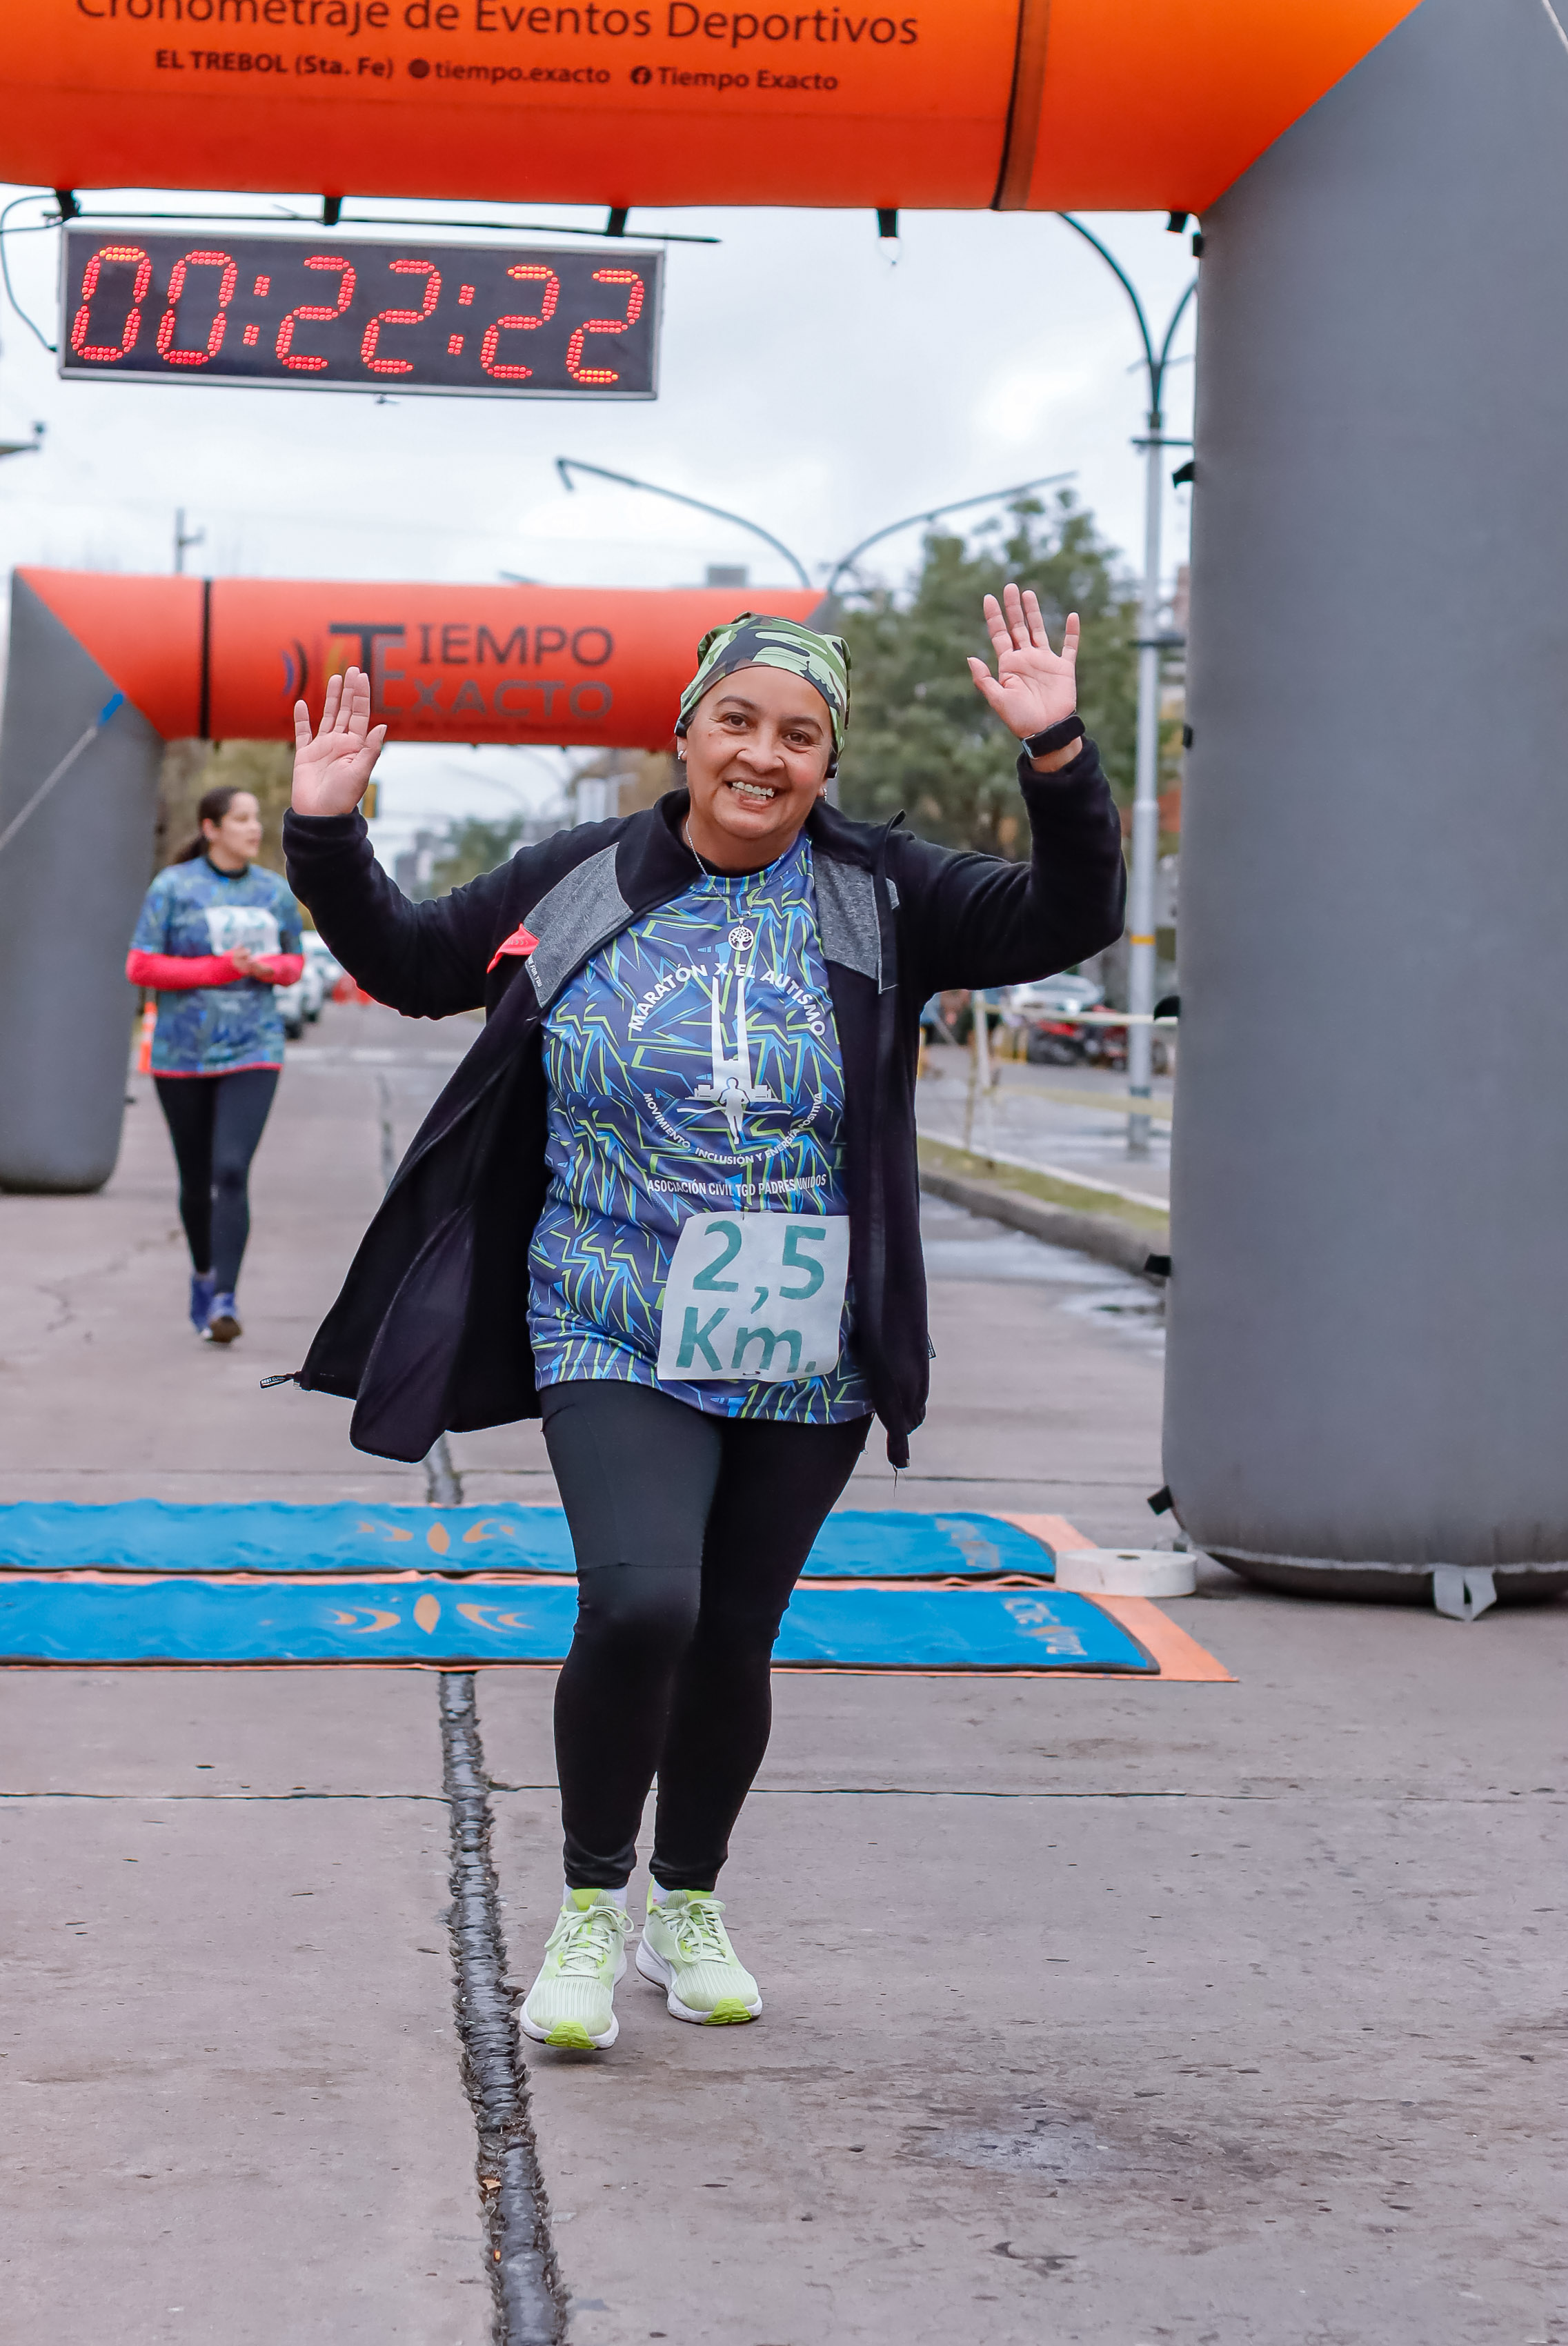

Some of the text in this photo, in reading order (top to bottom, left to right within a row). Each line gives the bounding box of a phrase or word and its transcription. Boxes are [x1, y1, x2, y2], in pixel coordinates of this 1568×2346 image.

[404, 0, 459, 30] de
[476, 0, 651, 35] Eventos
[668, 2, 918, 48] Deportivos
[156, 49, 838, 90] EL TREBOL (Sta. Fe) tiempo.exacto Tiempo Exacto
[71, 245, 645, 384] 00:22:22
[535, 975, 543, 987] YOU
[627, 963, 826, 1036] MARATÓN X EL AUTISMO
[695, 1147, 754, 1164] INCLUSIÓN
[755, 1152, 762, 1162] Y
[764, 1129, 800, 1158] ENERGÍA
[797, 1092, 822, 1129] POSITIVA
[647, 1173, 826, 1197] ASOCIACIÓN CIVIL TGD PADRES UNIDOS
[692, 1220, 826, 1315] 2,5
[675, 1306, 817, 1373] Km.
